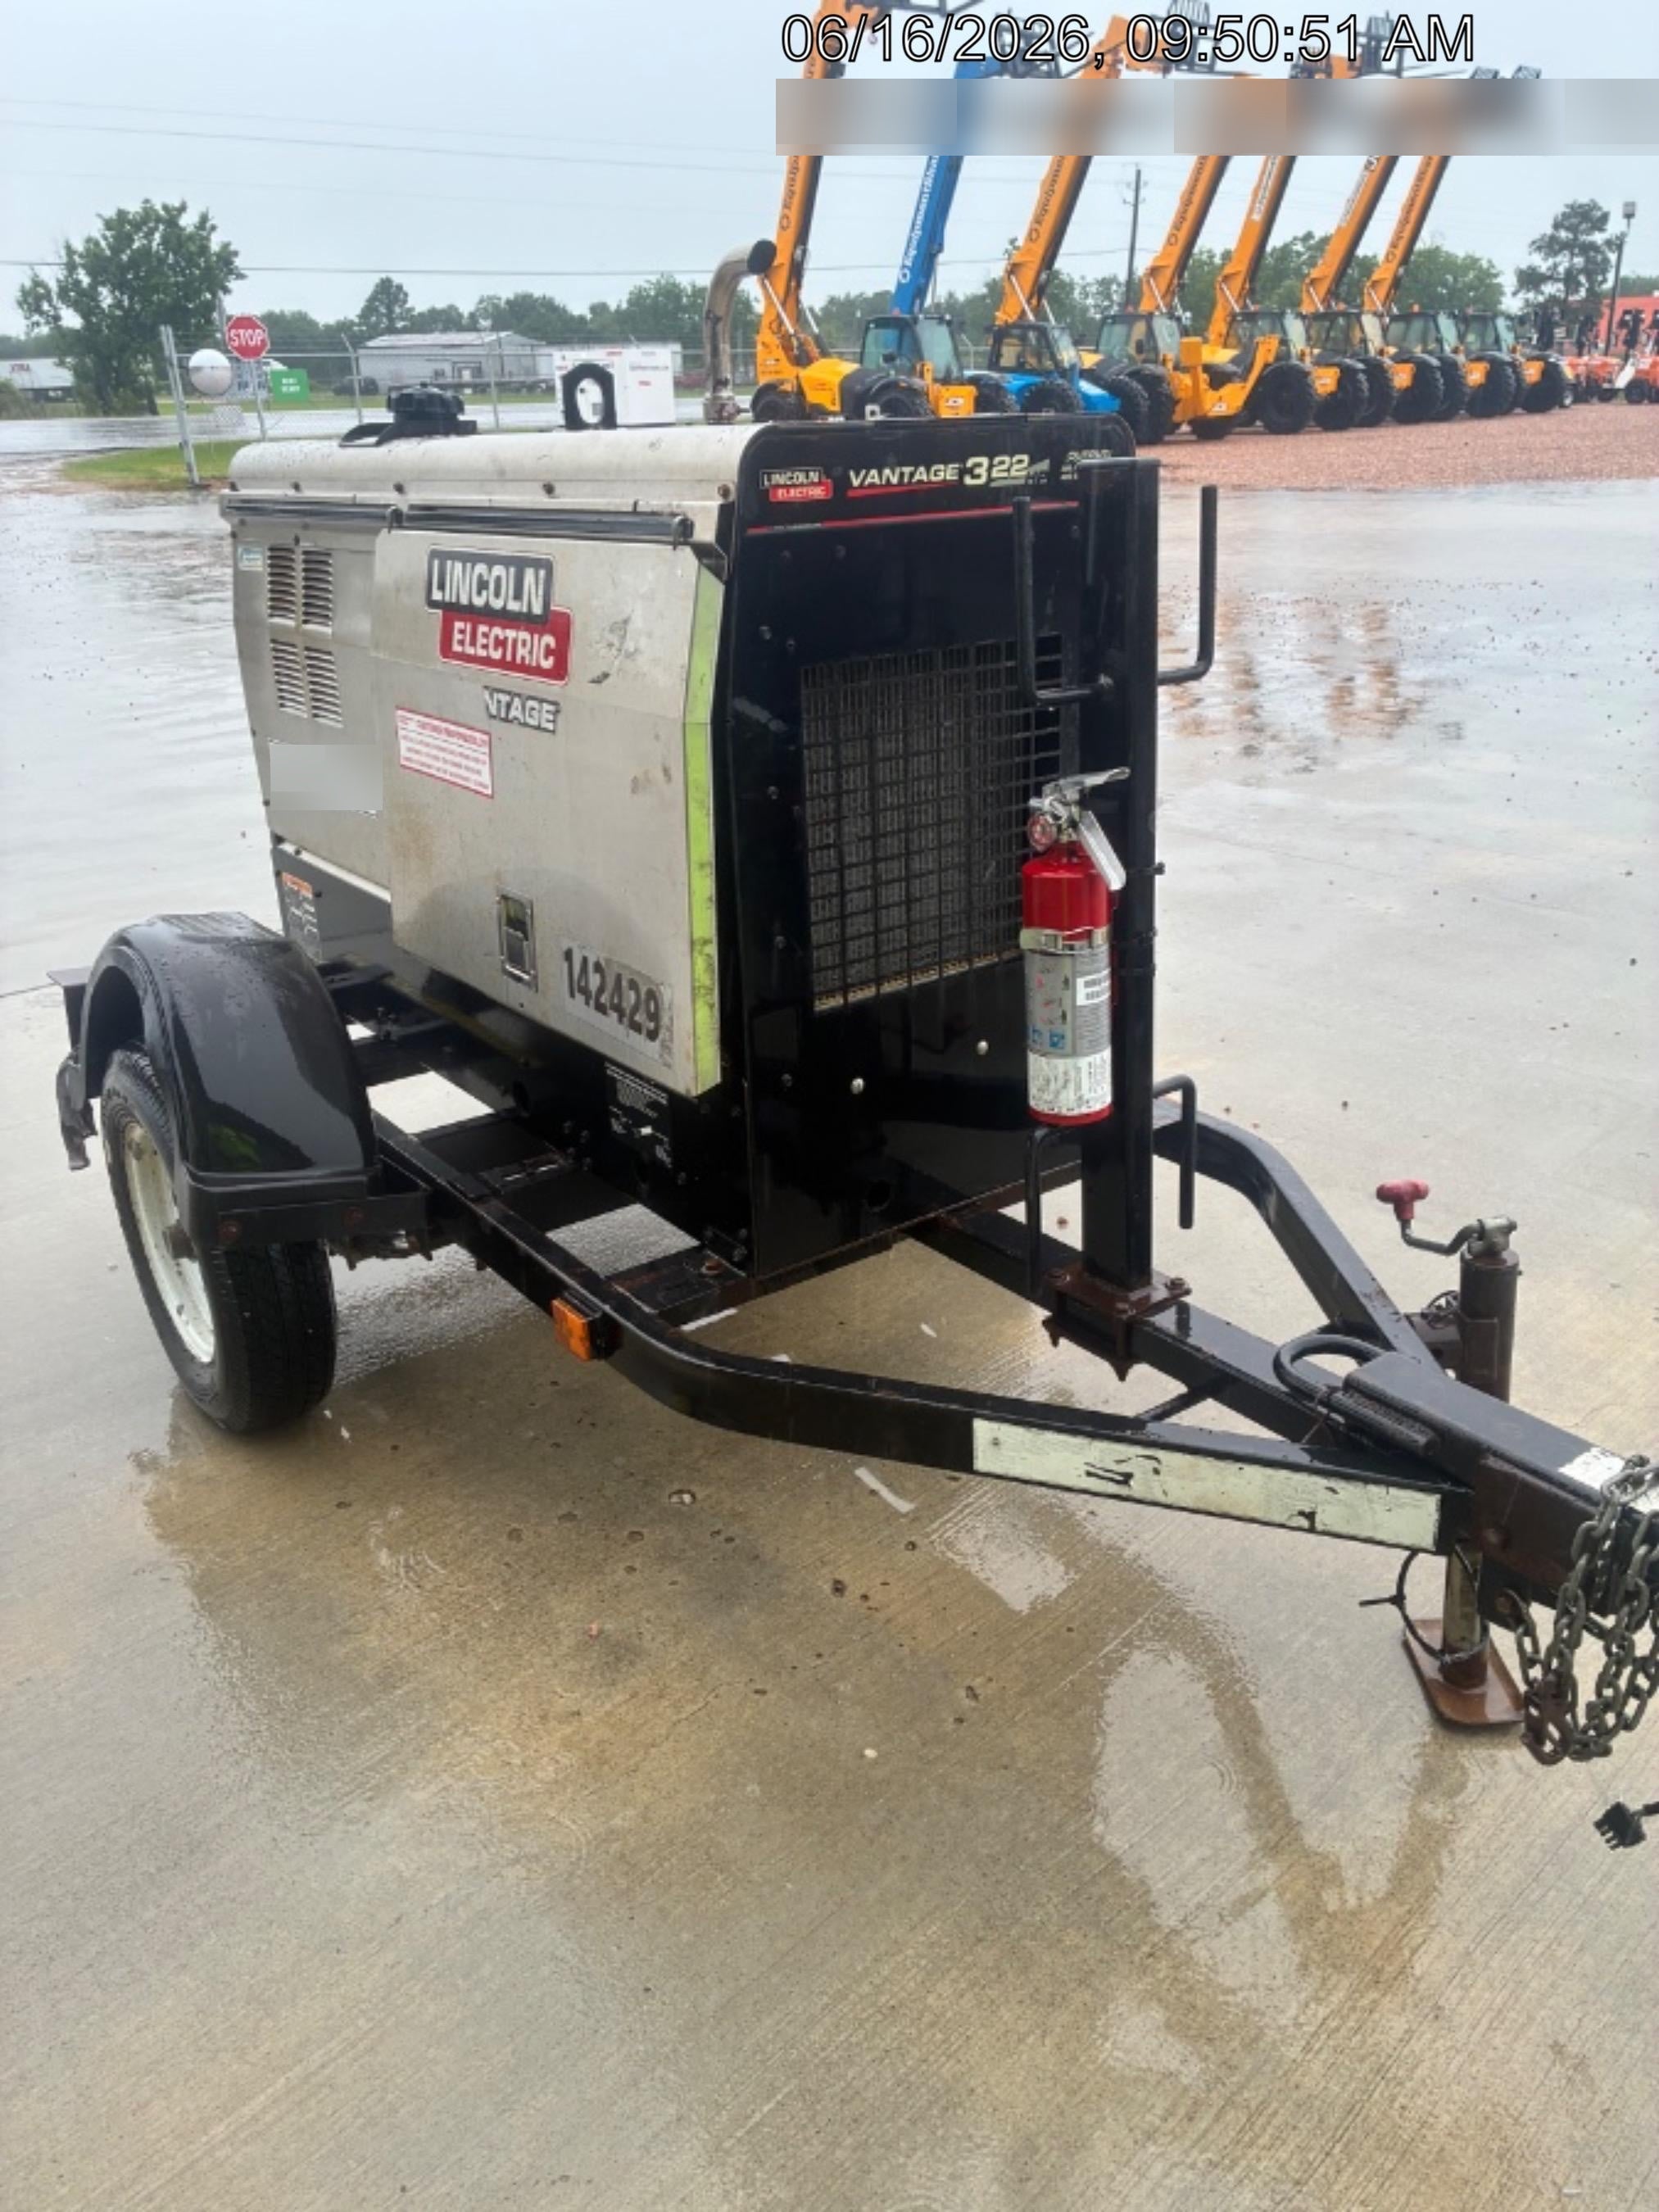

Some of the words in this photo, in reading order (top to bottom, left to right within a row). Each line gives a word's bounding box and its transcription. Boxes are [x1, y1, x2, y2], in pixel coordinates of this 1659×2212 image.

[229, 329, 265, 348] STOP
[763, 470, 820, 486] LINCOLN
[849, 463, 961, 487] VANTAGE
[963, 454, 1030, 486] 322
[777, 486, 827, 499] ELECTRIC
[430, 558, 547, 615] LINCOLN
[451, 620, 556, 669] ELECTRIC
[564, 946, 660, 1044] 142429
